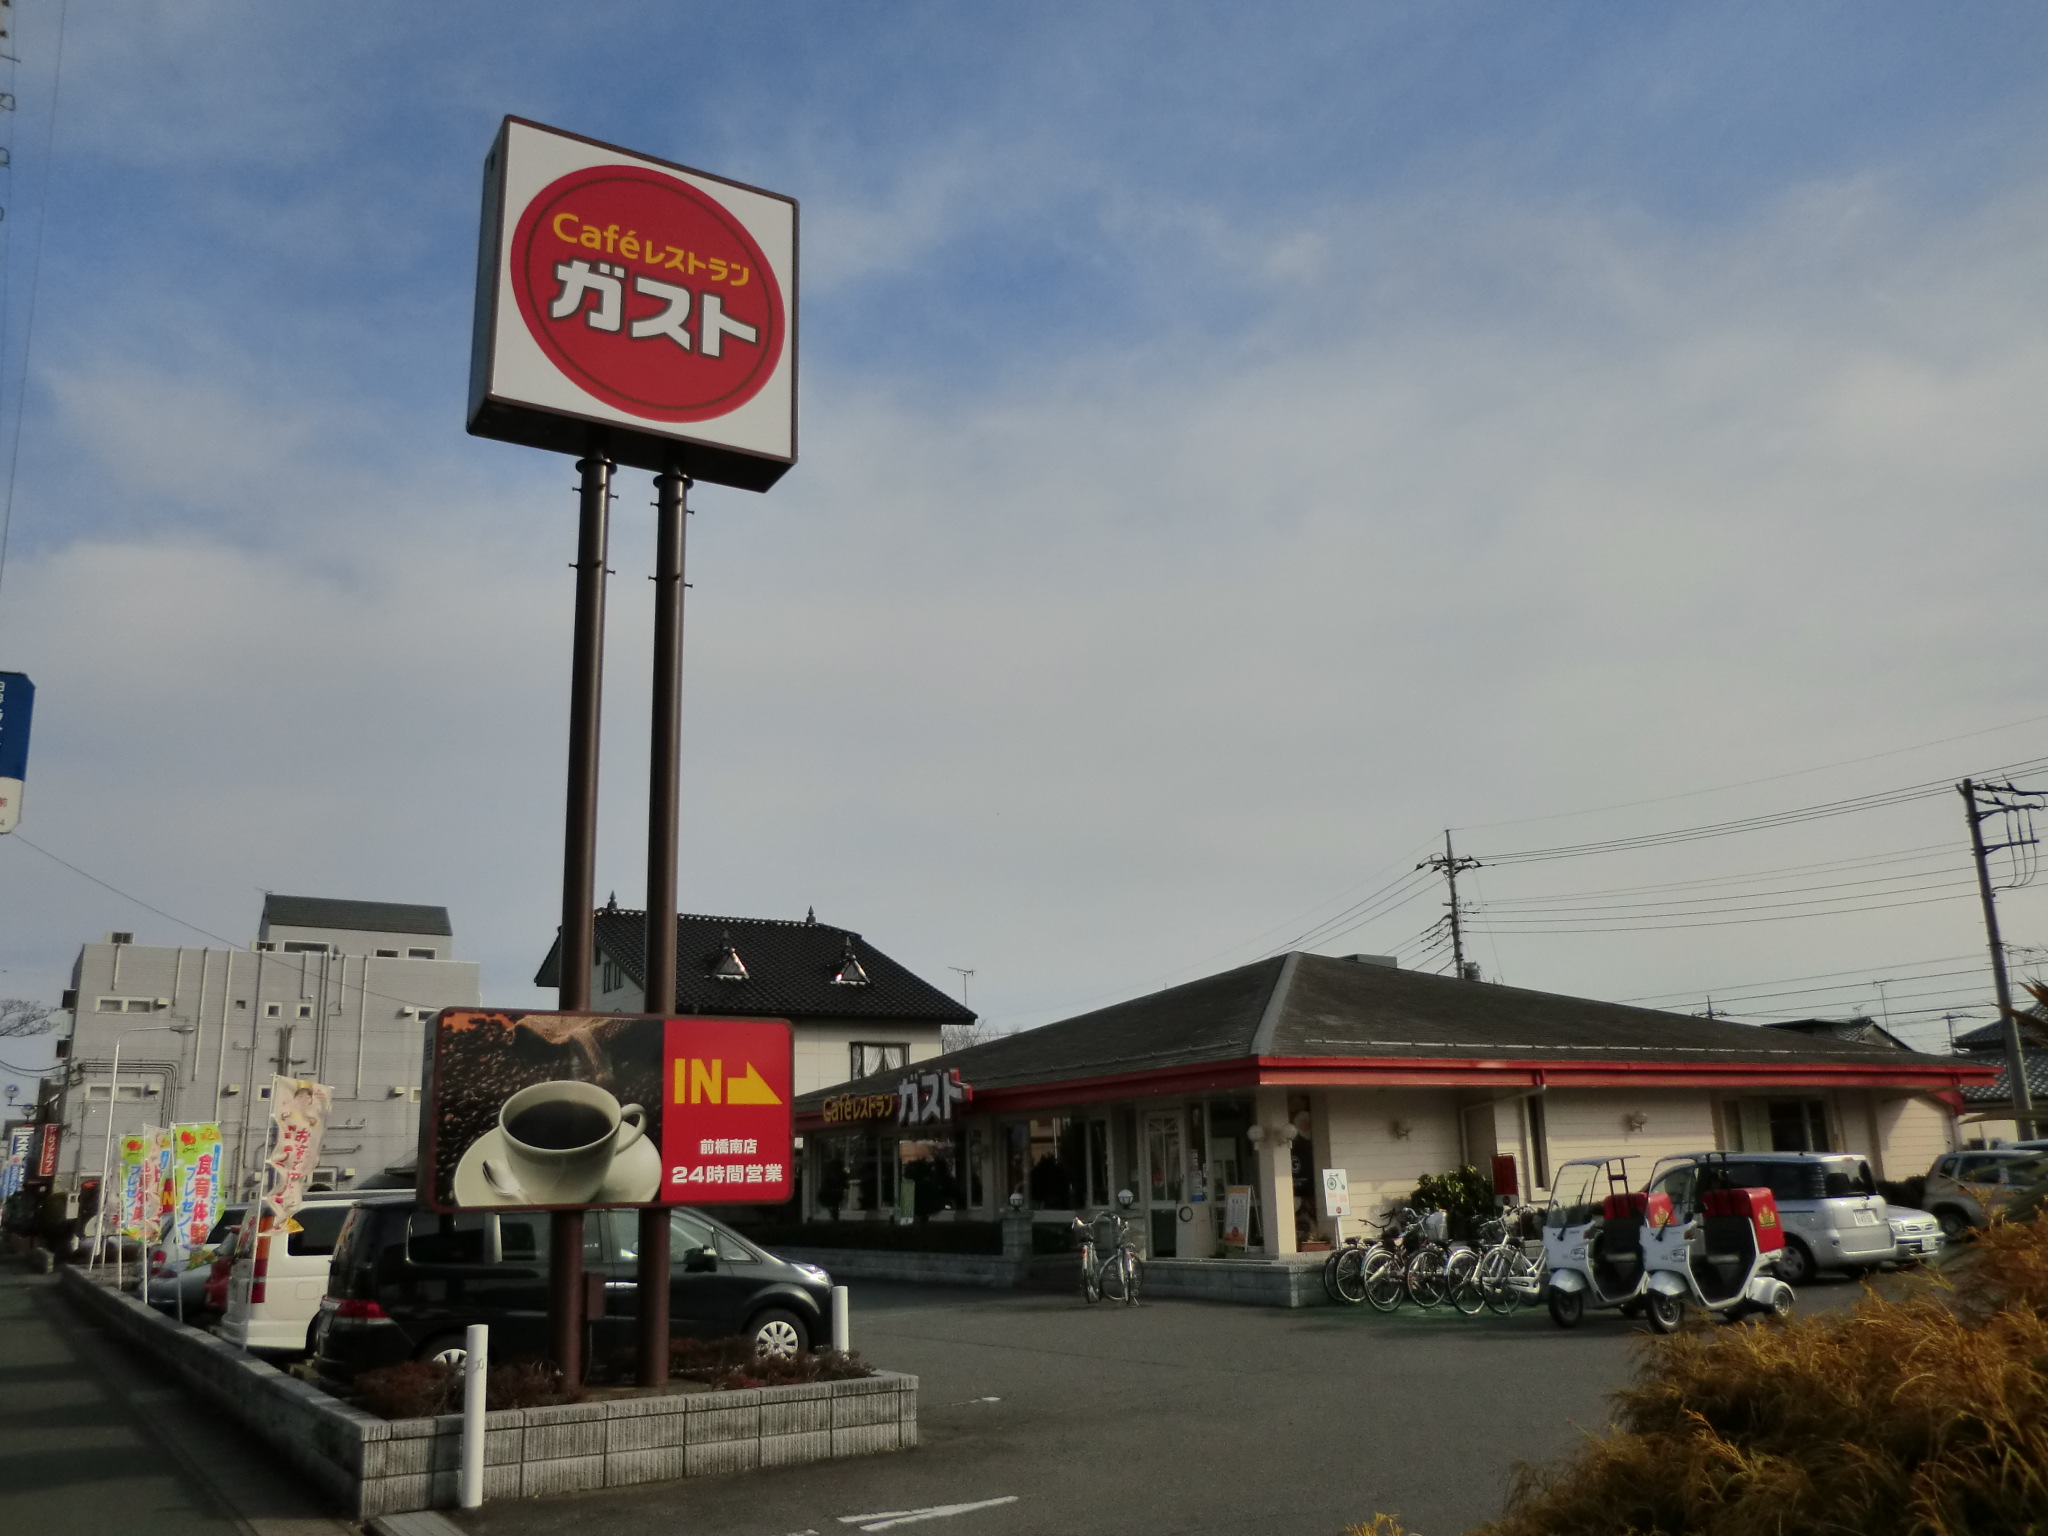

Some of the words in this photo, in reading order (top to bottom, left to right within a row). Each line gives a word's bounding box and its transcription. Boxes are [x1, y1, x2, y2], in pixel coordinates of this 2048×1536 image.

[552, 259, 757, 358] ガスト
[674, 1058, 722, 1105] IN
[898, 1071, 964, 1124] ガスト
[700, 1138, 758, 1155] 前橋南店
[672, 1163, 783, 1184] 24時間営業
